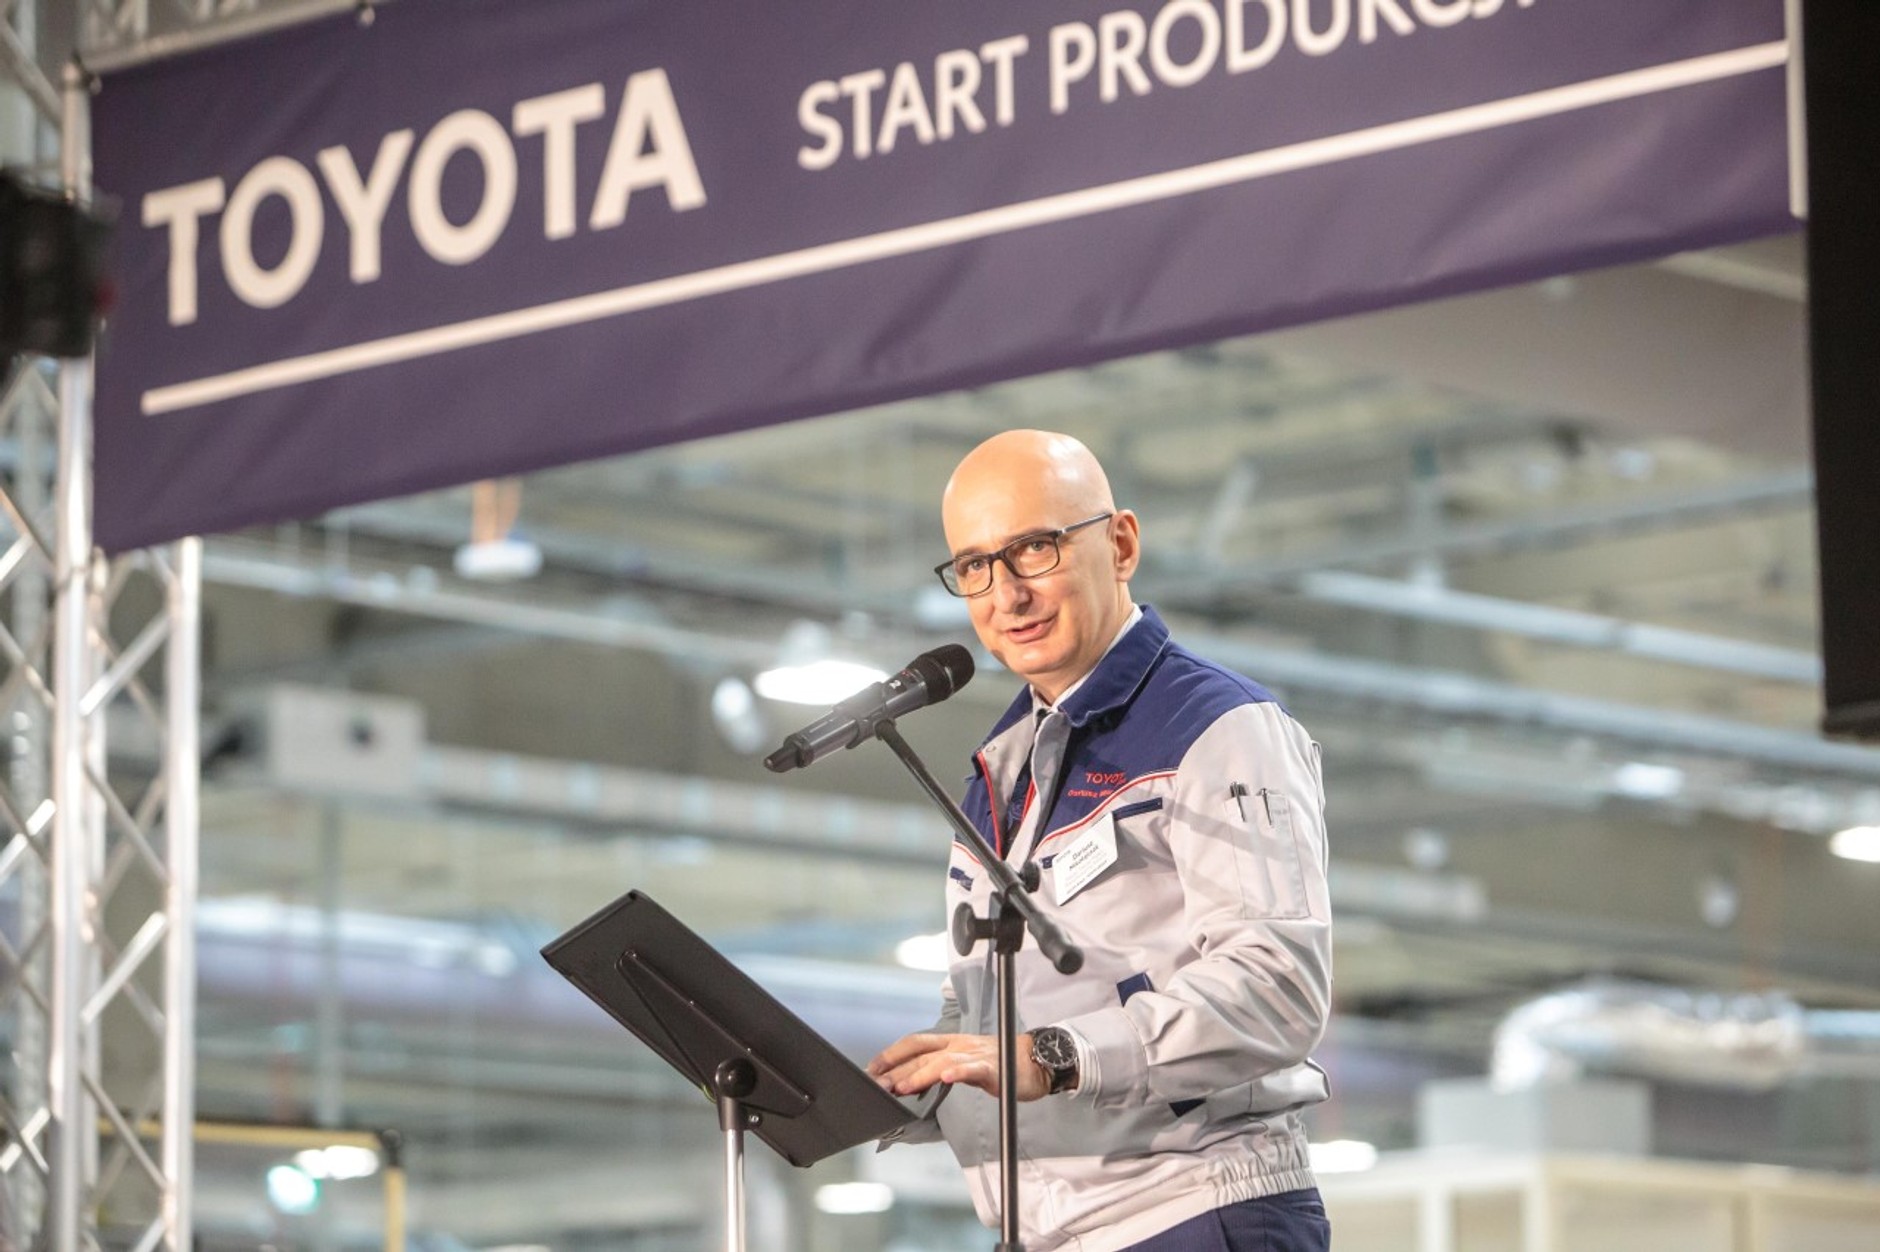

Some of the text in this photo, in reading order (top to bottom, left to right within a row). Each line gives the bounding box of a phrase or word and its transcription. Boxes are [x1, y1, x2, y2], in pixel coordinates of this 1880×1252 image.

[798, 0, 1534, 169] START PRODU
[142, 67, 708, 327] TOYOTA
